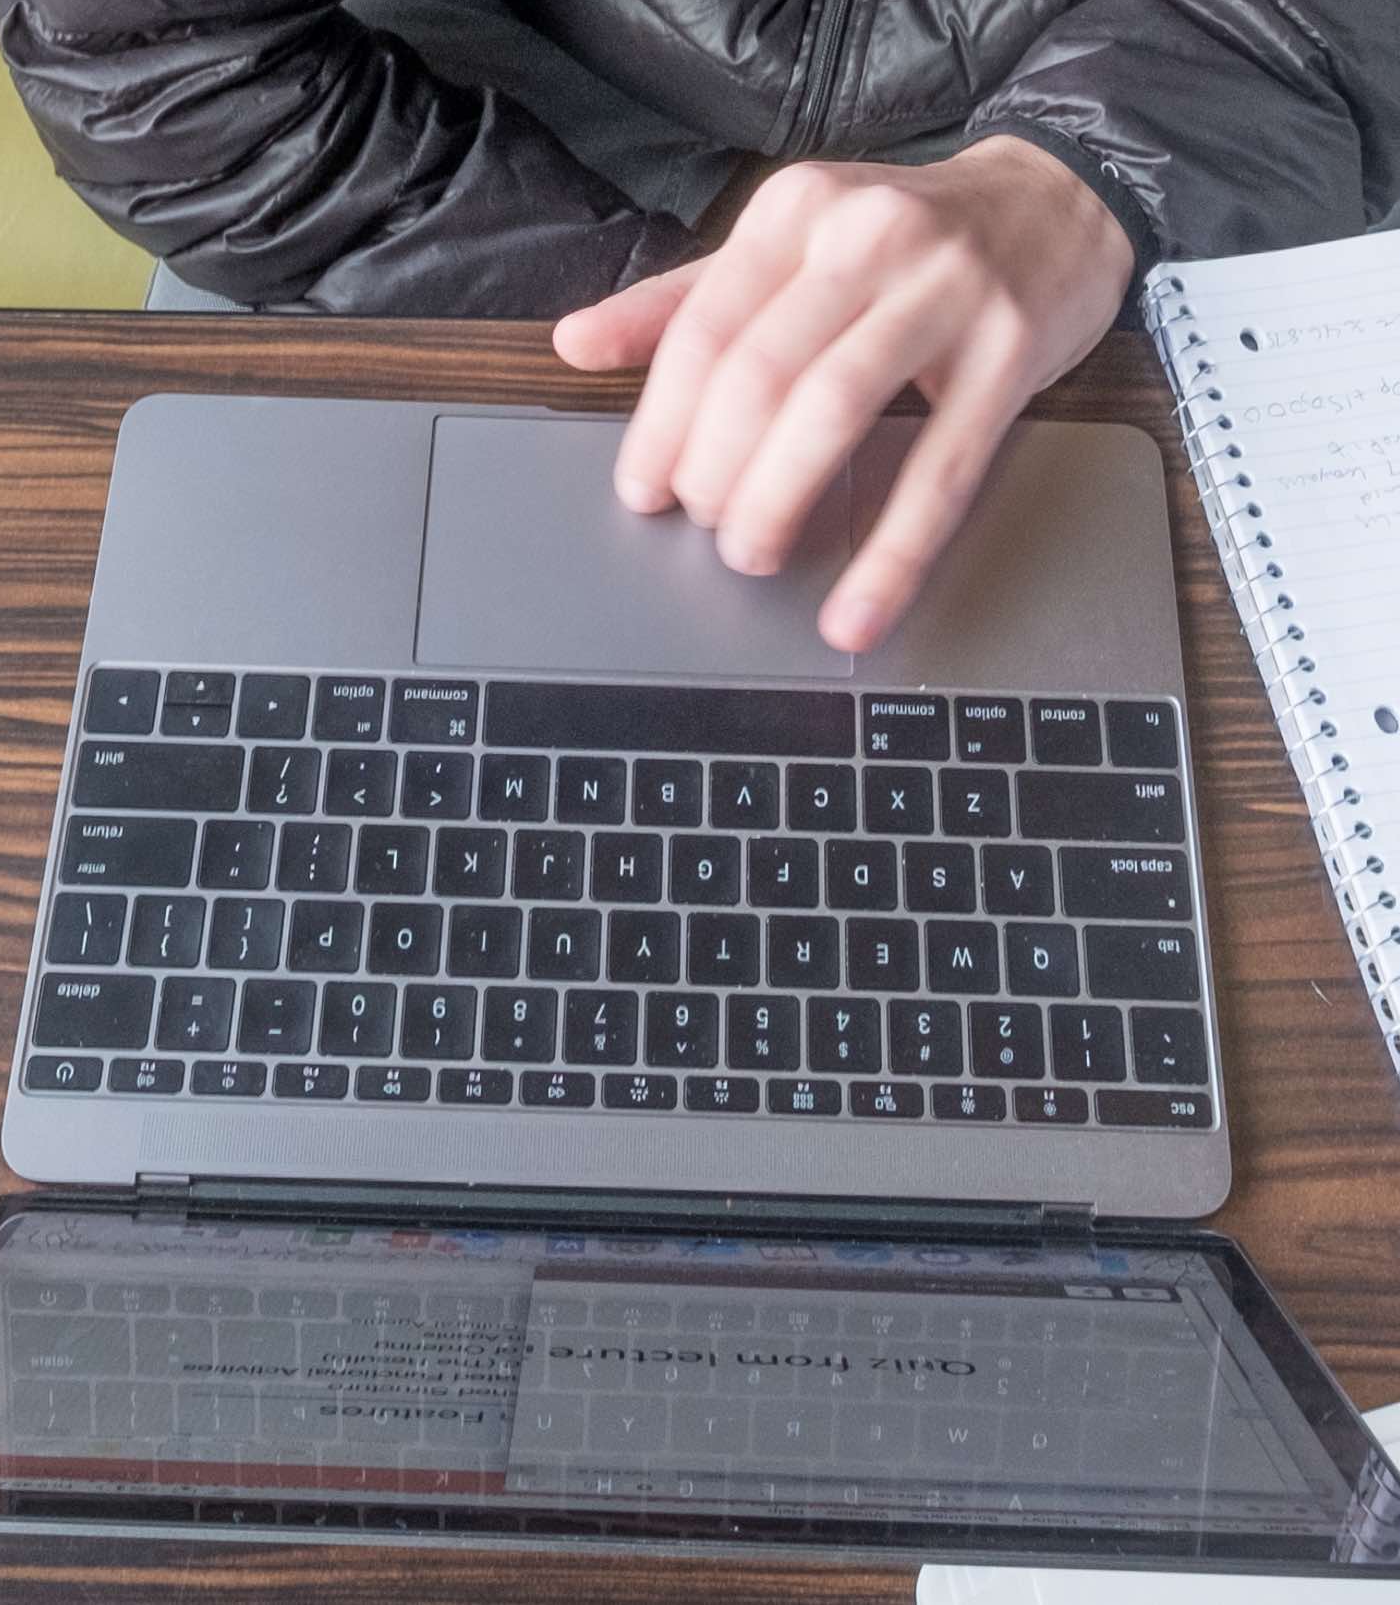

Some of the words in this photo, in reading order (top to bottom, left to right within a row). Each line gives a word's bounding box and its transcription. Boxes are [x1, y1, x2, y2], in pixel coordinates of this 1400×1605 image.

[333, 684, 375, 701] option
[403, 687, 469, 702] command
[871, 702, 936, 717] command
[965, 705, 1007, 722] option
[1040, 708, 1086, 722] control
[1145, 711, 1160, 727] fn
[356, 721, 371, 734] alt
[93, 750, 125, 766] shift
[967, 741, 982, 754] alt
[505, 777, 524, 799] M
[582, 779, 599, 802] N
[660, 782, 675, 803] B
[736, 785, 752, 806] V
[813, 786, 829, 809] C
[1134, 783, 1166, 799] shift
[890, 789, 906, 811] X
[966, 792, 983, 817] Z
[82, 824, 124, 840] return
[76, 862, 107, 875] enter
[386, 848, 398, 871] L
[463, 851, 478, 873] K
[542, 854, 555, 875] J
[619, 855, 635, 878] H
[697, 858, 713, 881] G
[1111, 858, 1138, 871] lock
[1141, 858, 1173, 874] caps
[776, 861, 790, 883] F
[853, 864, 869, 886] D
[932, 866, 947, 889] S
[1009, 868, 1025, 891] A
[318, 925, 334, 948] P
[397, 927, 413, 950] O
[480, 929, 487, 952] I
[555, 932, 572, 955] U
[636, 935, 652, 958] Y
[1157, 938, 1181, 954] tab
[715, 937, 731, 961] T
[796, 940, 811, 963] R
[876, 942, 890, 965] E
[951, 946, 974, 969] W
[1033, 945, 1050, 971] Q
[56, 982, 101, 1000] delete
[351, 993, 366, 1017] 0
[432, 995, 446, 1019] 9
[513, 998, 528, 1022] 8
[593, 1002, 607, 1025] 7
[675, 1004, 689, 1027] 6
[755, 1006, 769, 1030] 5
[835, 1009, 851, 1032] 4
[917, 1012, 931, 1035] 3
[998, 1015, 1012, 1038] 2
[1082, 1018, 1092, 1041] 1
[1170, 1101, 1196, 1116] esc
[549, 1344, 715, 1369] lecture
[736, 1349, 850, 1375] from
[319, 1405, 485, 1424] Features
